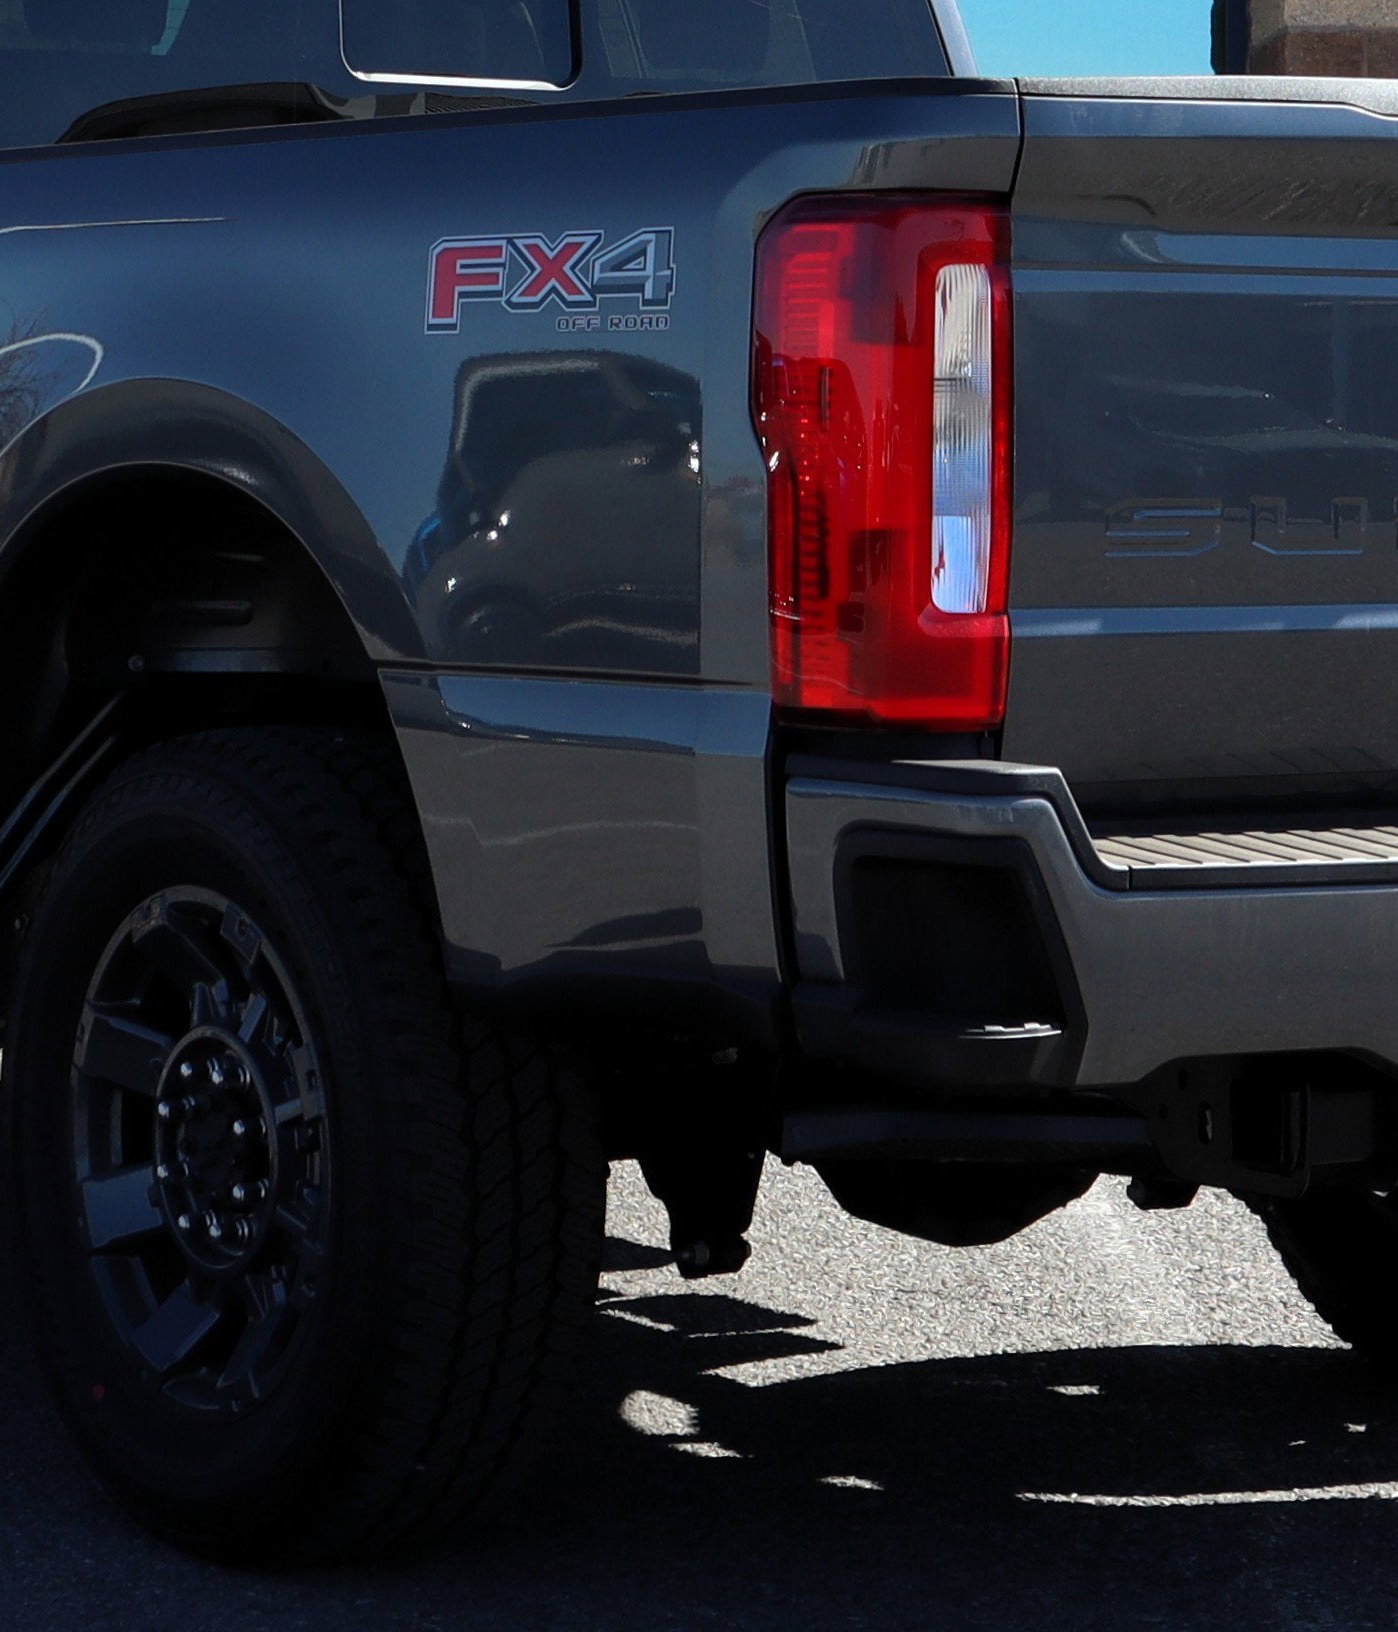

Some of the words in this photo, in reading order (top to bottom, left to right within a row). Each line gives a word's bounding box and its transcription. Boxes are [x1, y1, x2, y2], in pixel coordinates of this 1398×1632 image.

[424, 226, 677, 335] FX4
[556, 315, 601, 332] OFF
[607, 314, 670, 331] ROAD
